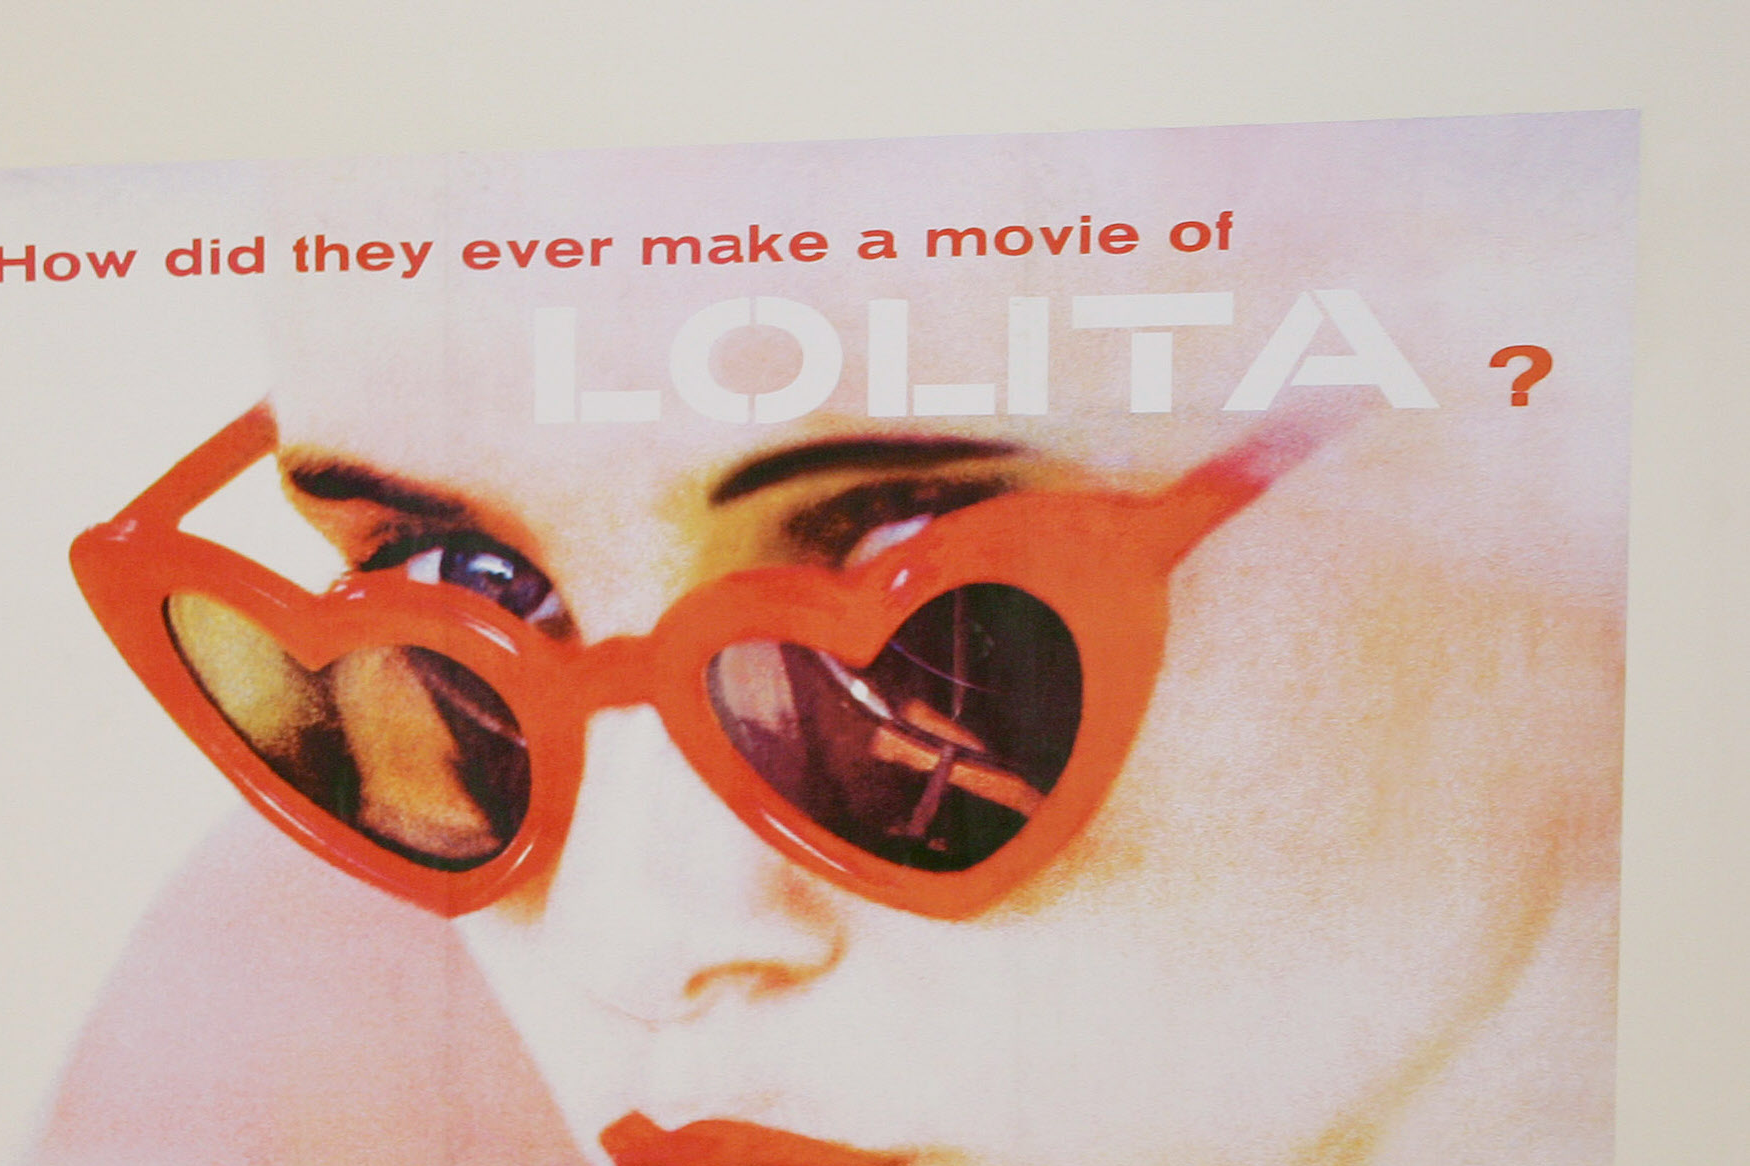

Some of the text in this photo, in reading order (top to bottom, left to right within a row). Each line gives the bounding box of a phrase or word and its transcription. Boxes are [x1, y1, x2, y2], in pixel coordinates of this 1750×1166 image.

[166, 236, 264, 277] did
[293, 235, 433, 279] they
[462, 238, 613, 270] ever
[642, 225, 828, 265] make
[858, 230, 897, 259] a
[927, 215, 1139, 257] movie
[1170, 211, 1233, 252] of
[533, 290, 1553, 424] LOLITA ?
